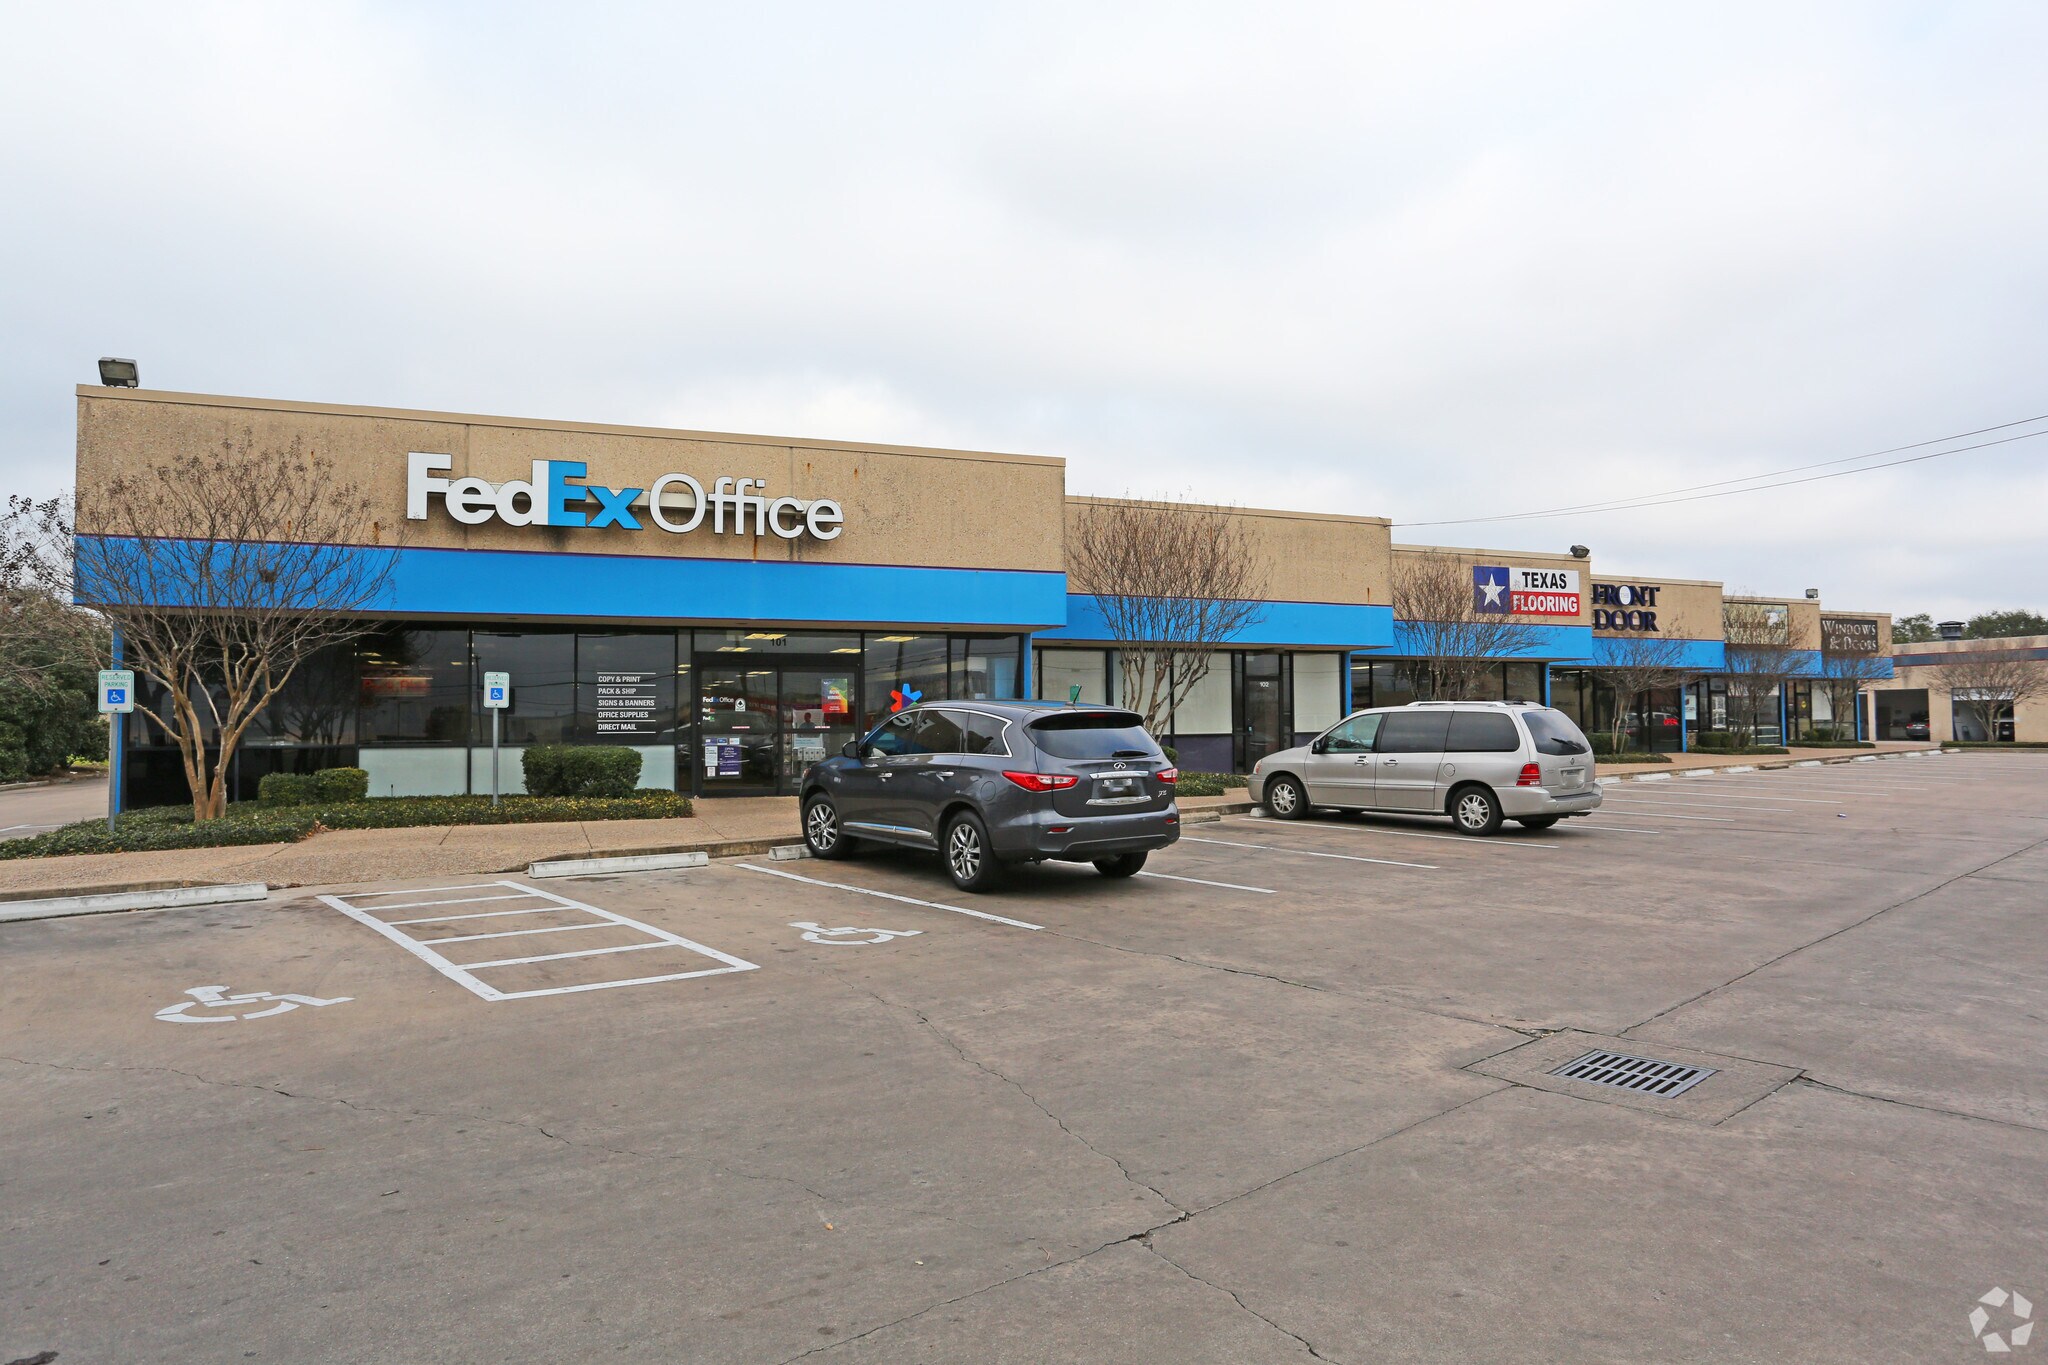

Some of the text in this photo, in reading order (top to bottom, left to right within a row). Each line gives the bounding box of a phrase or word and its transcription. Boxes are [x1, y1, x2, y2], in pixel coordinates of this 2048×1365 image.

[407, 451, 845, 541] FedEx Office
[1522, 571, 1567, 589] TEXAS
[1512, 594, 1578, 613] FLOORING
[1591, 584, 1661, 607] FRONT
[1592, 608, 1660, 632] DOOR
[770, 637, 787, 646] 101
[1830, 635, 1841, 650] &
[625, 699, 655, 707] BANNERS
